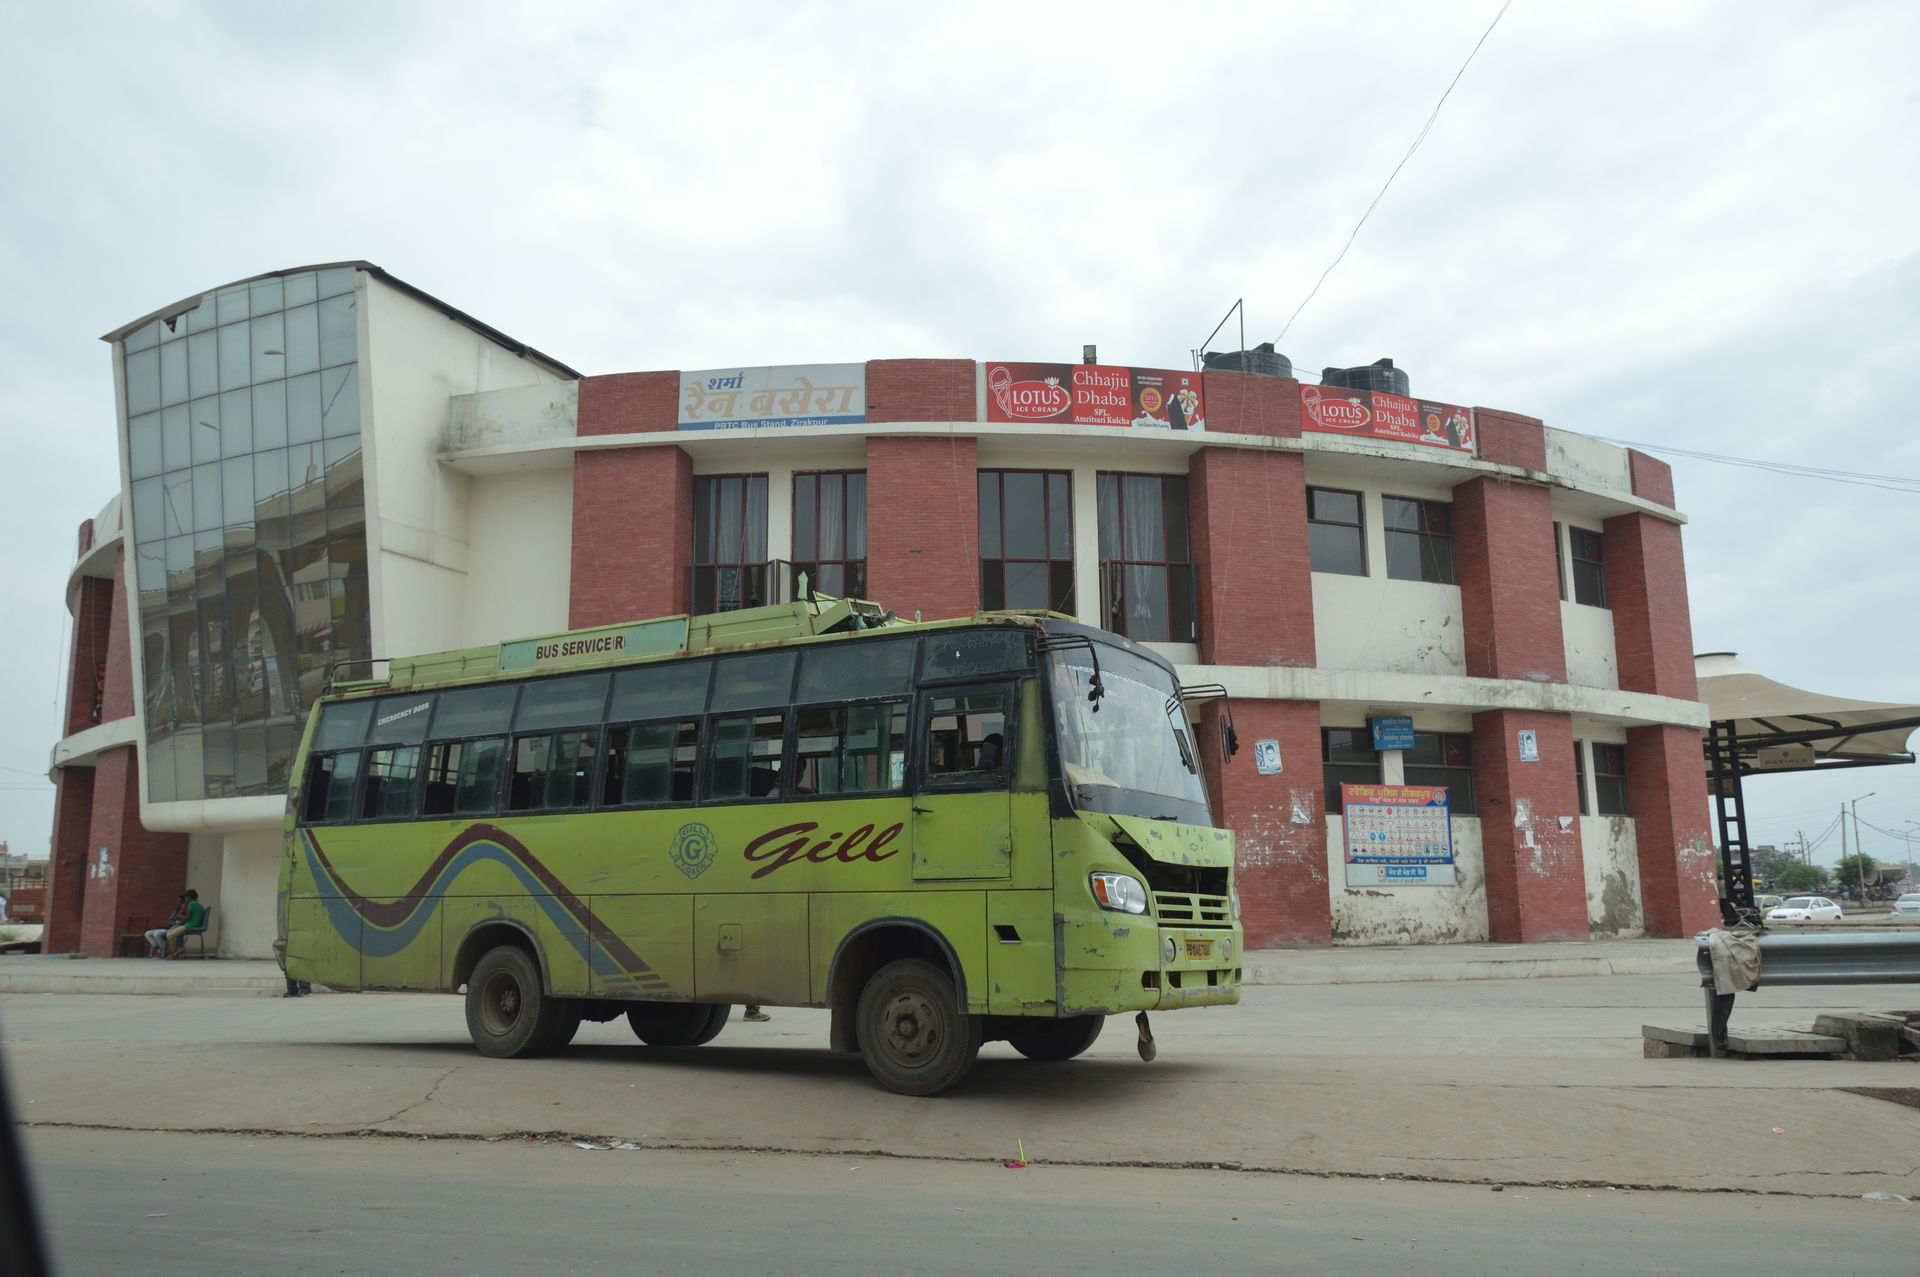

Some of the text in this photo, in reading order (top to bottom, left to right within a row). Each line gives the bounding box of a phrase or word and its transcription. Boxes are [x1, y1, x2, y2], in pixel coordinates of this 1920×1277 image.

[707, 372, 745, 390] शर्मा
[1073, 371, 1129, 390] Chhajju
[685, 377, 859, 419] रैन बसेरा
[1013, 389, 1060, 405] LOTUS
[1076, 390, 1126, 407] Dhaba
[1372, 396, 1418, 412] Chhajju's
[1322, 405, 1362, 419] LOTUS
[1376, 410, 1416, 427] Dhaba
[714, 421, 739, 430] PRTC
[741, 420, 759, 429] Bus
[1074, 416, 1107, 424] Amritsari
[1107, 416, 1130, 426] Kulcha
[536, 642, 559, 660] BUS
[681, 824, 706, 836] GILL
[685, 839, 703, 861] G
[743, 822, 904, 880] Gill
